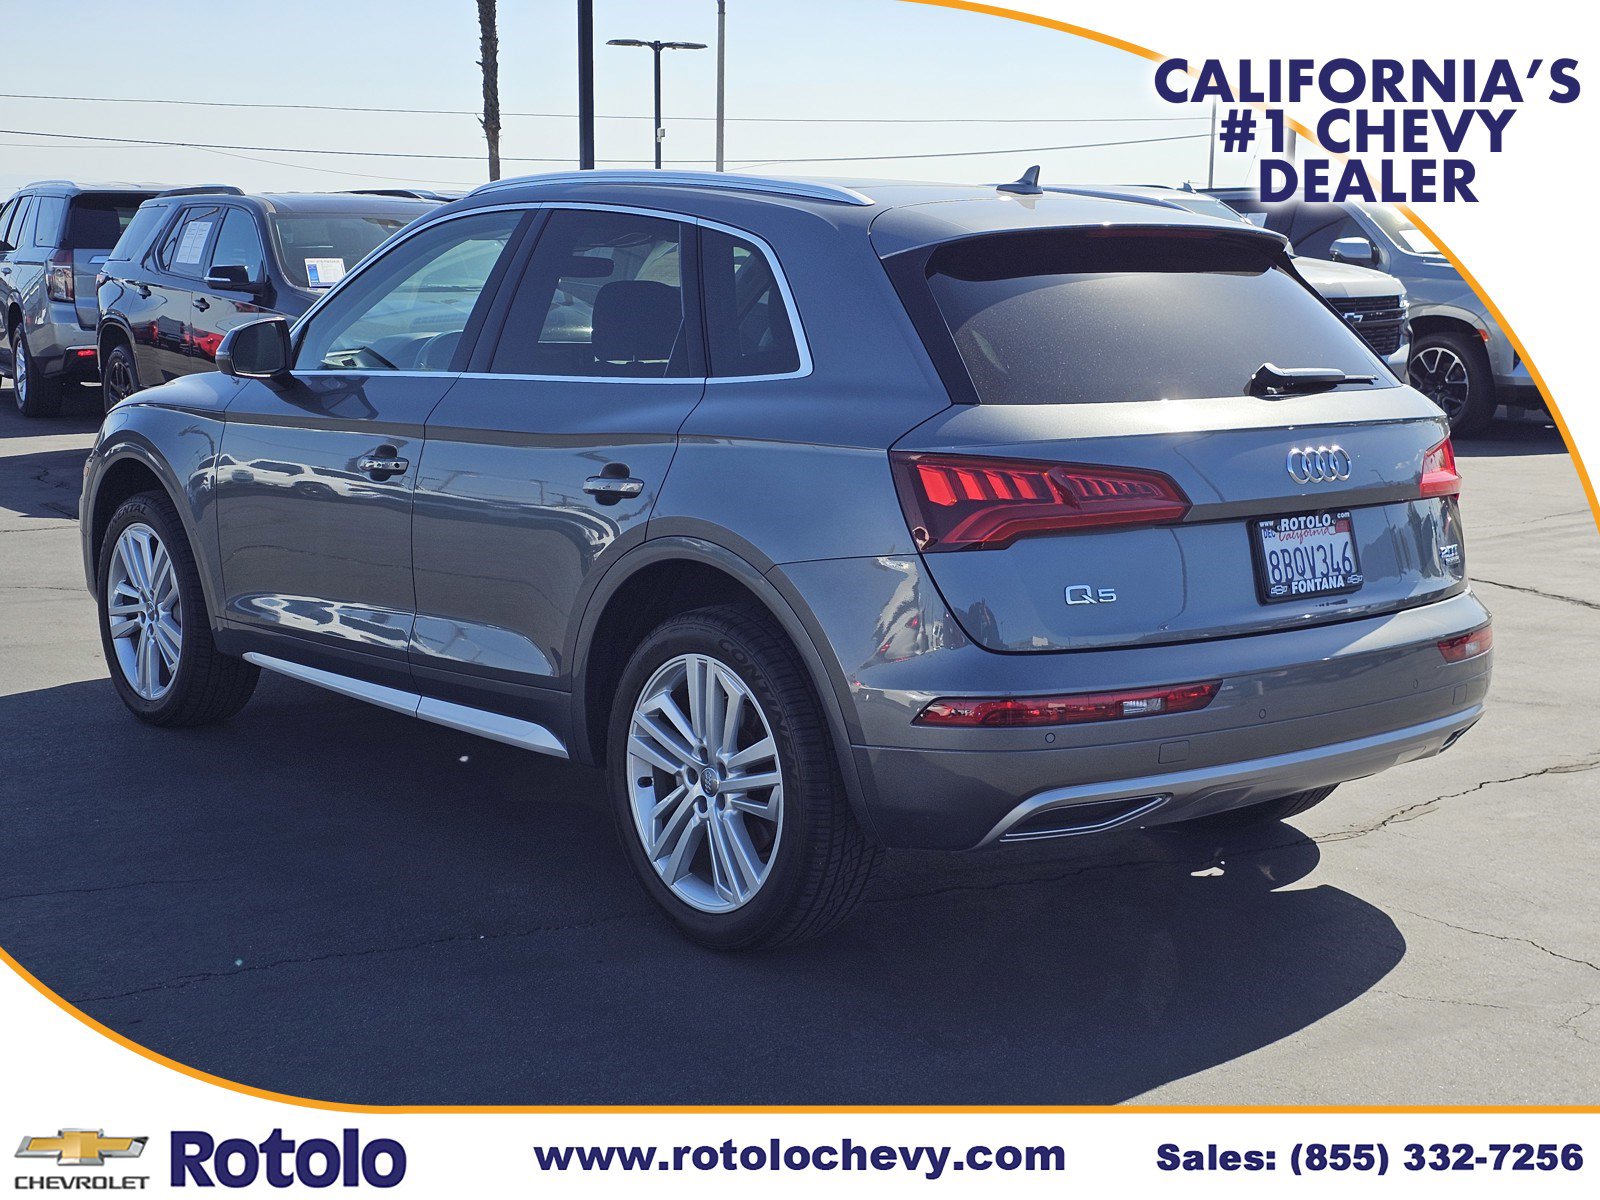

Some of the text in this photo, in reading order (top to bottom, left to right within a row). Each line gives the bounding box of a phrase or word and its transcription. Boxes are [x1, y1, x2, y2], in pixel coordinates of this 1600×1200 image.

[1280, 513, 1331, 532] ROTOLO
[1336, 511, 1350, 519] com
[1268, 541, 1353, 585] 8BQV346
[1065, 584, 1117, 605] Q5
[1291, 575, 1345, 595] FONTANA
